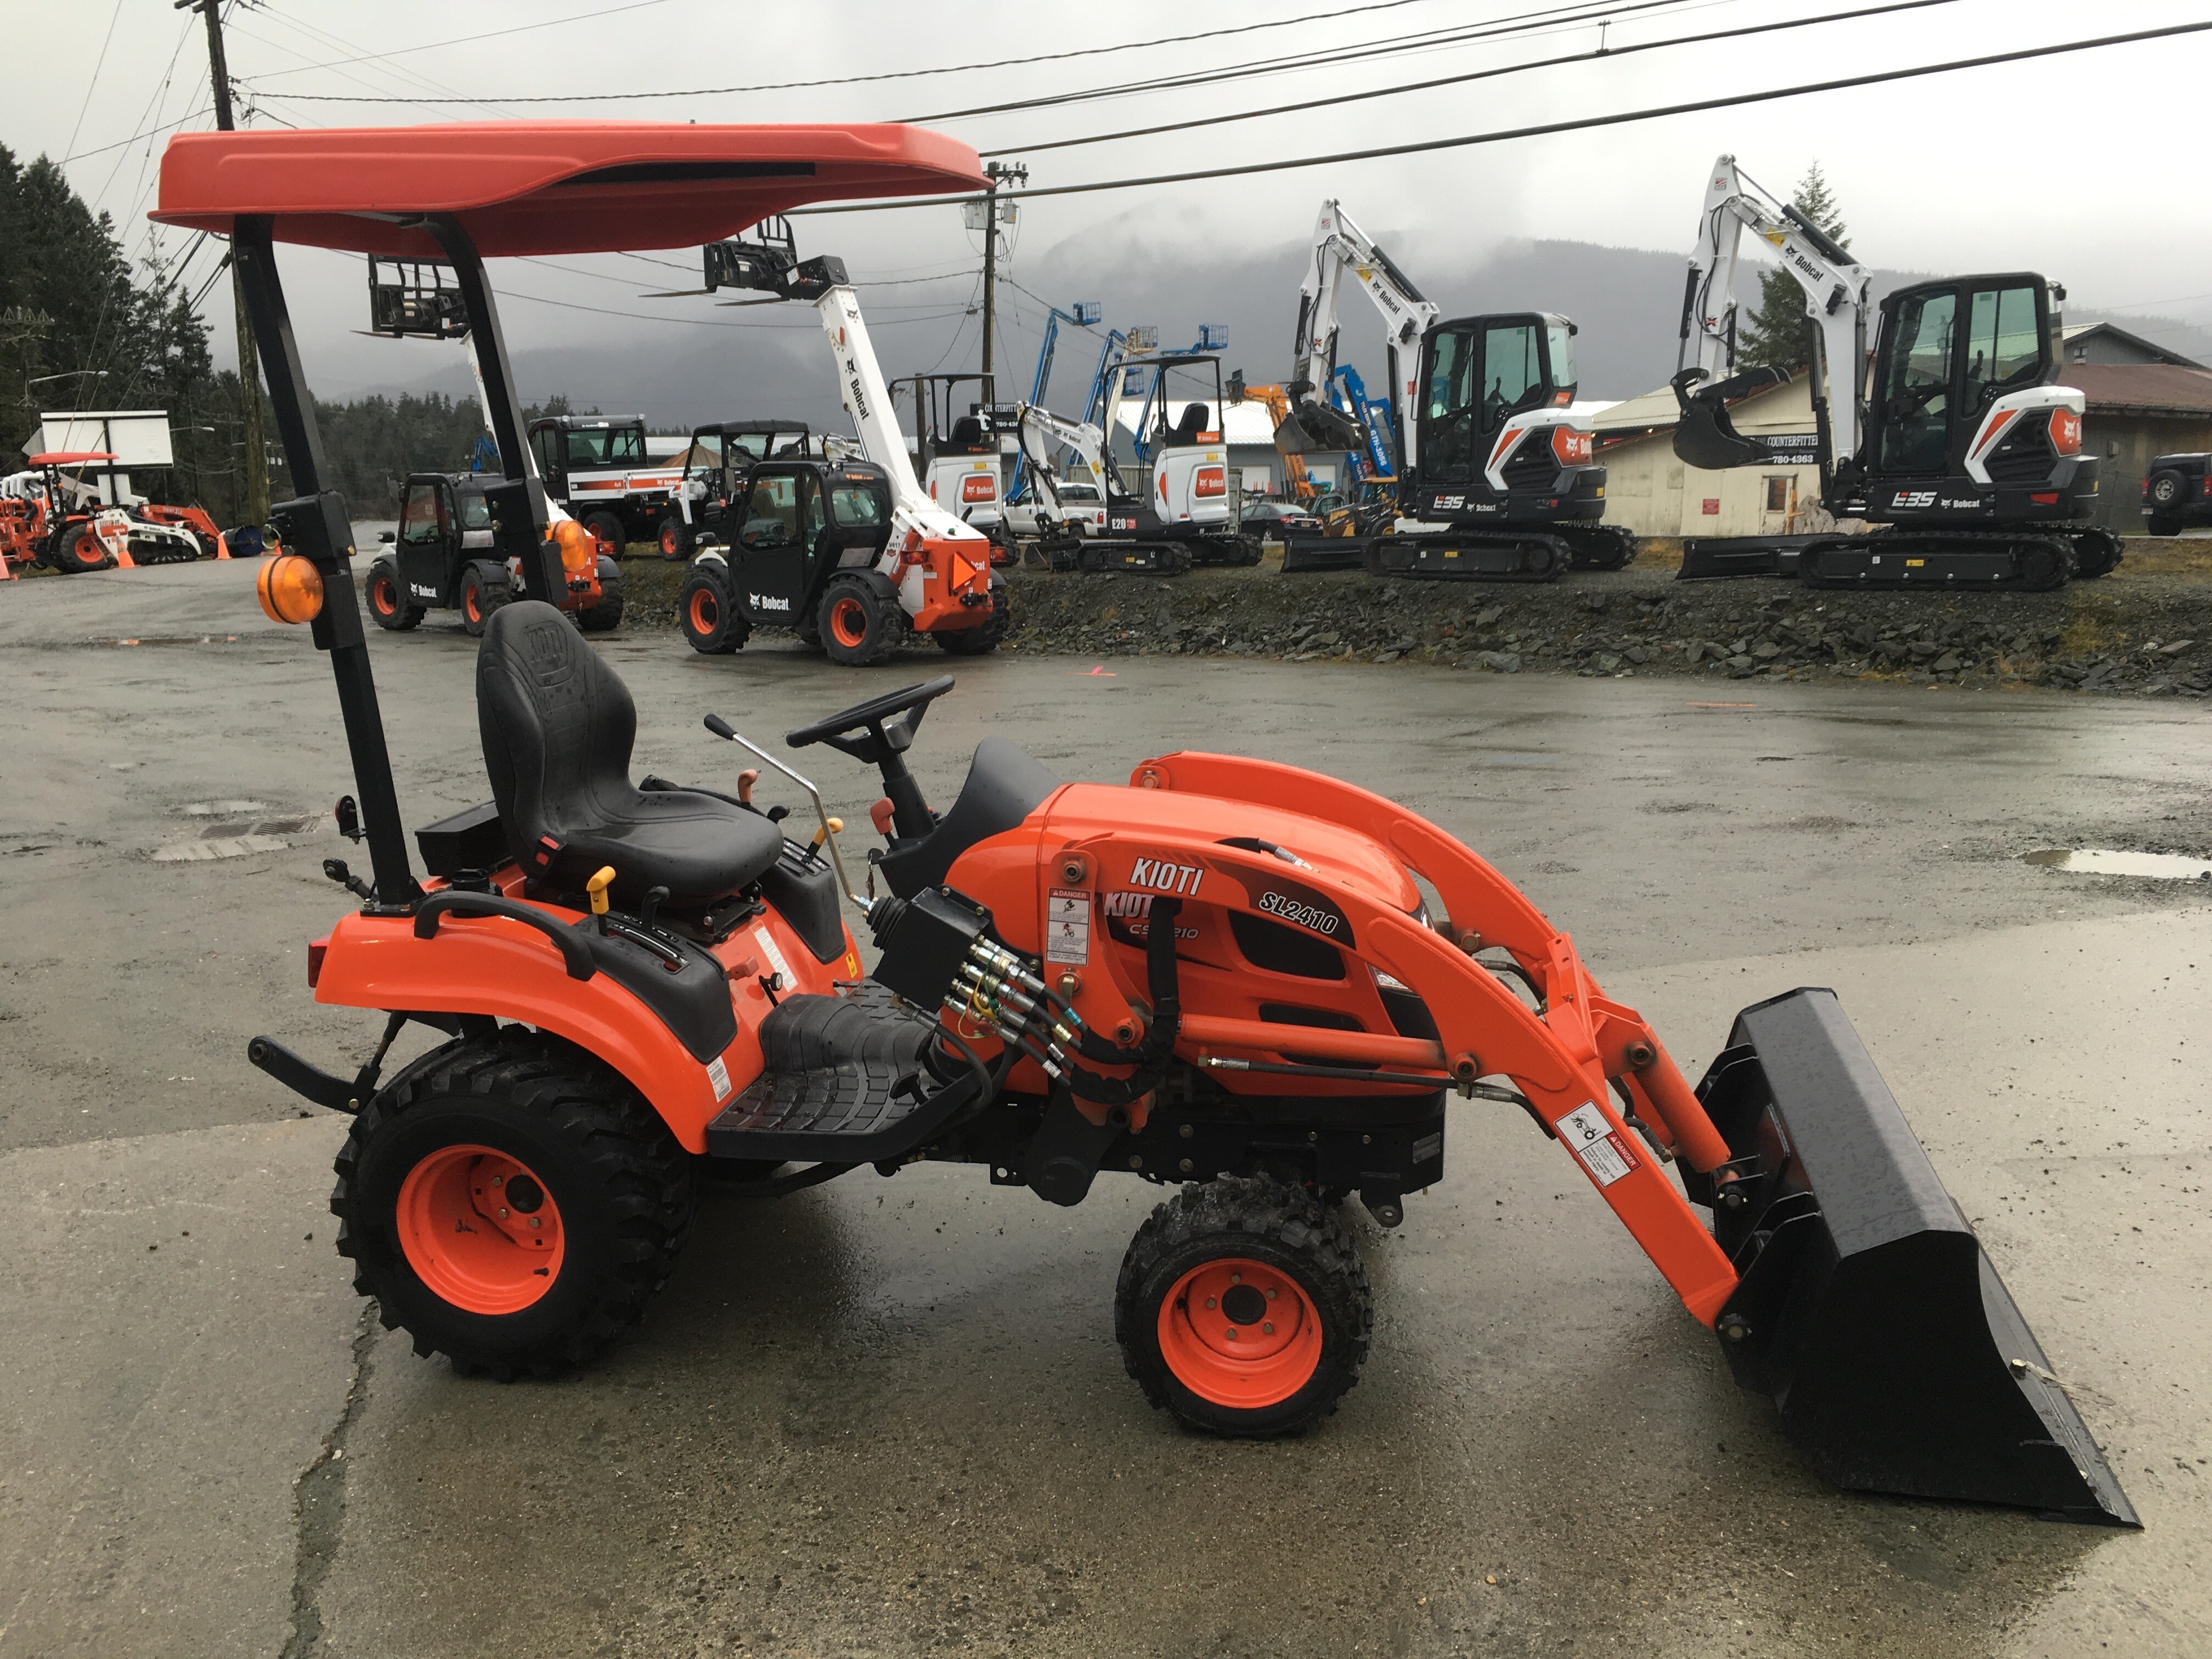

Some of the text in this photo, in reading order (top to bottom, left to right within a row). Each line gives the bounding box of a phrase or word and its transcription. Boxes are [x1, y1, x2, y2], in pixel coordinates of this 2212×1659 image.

[1795, 255, 1824, 282] Bobcat
[1379, 290, 1401, 315] Bobcat
[850, 378, 870, 421] Bobcat
[1370, 430, 1387, 466] GTH-1056
[1773, 454, 1814, 464] 780-4363
[977, 486, 994, 495] Bobcat
[1209, 478, 1224, 488] Bobcat
[1433, 495, 1465, 509] E35
[1892, 492, 1938, 507] E35
[1953, 499, 1980, 508] Bobcat
[1476, 504, 1497, 512] Bobcat
[1112, 518, 1126, 530] E20
[419, 585, 436, 598] Bobcat
[762, 596, 789, 611] Bobcat
[1130, 857, 1204, 896] KIOTI
[1059, 890, 1086, 899] DANGER
[1104, 892, 1155, 918] KIOT
[1259, 891, 1338, 934] SL2410
[1615, 1139, 1637, 1167] DANGER
